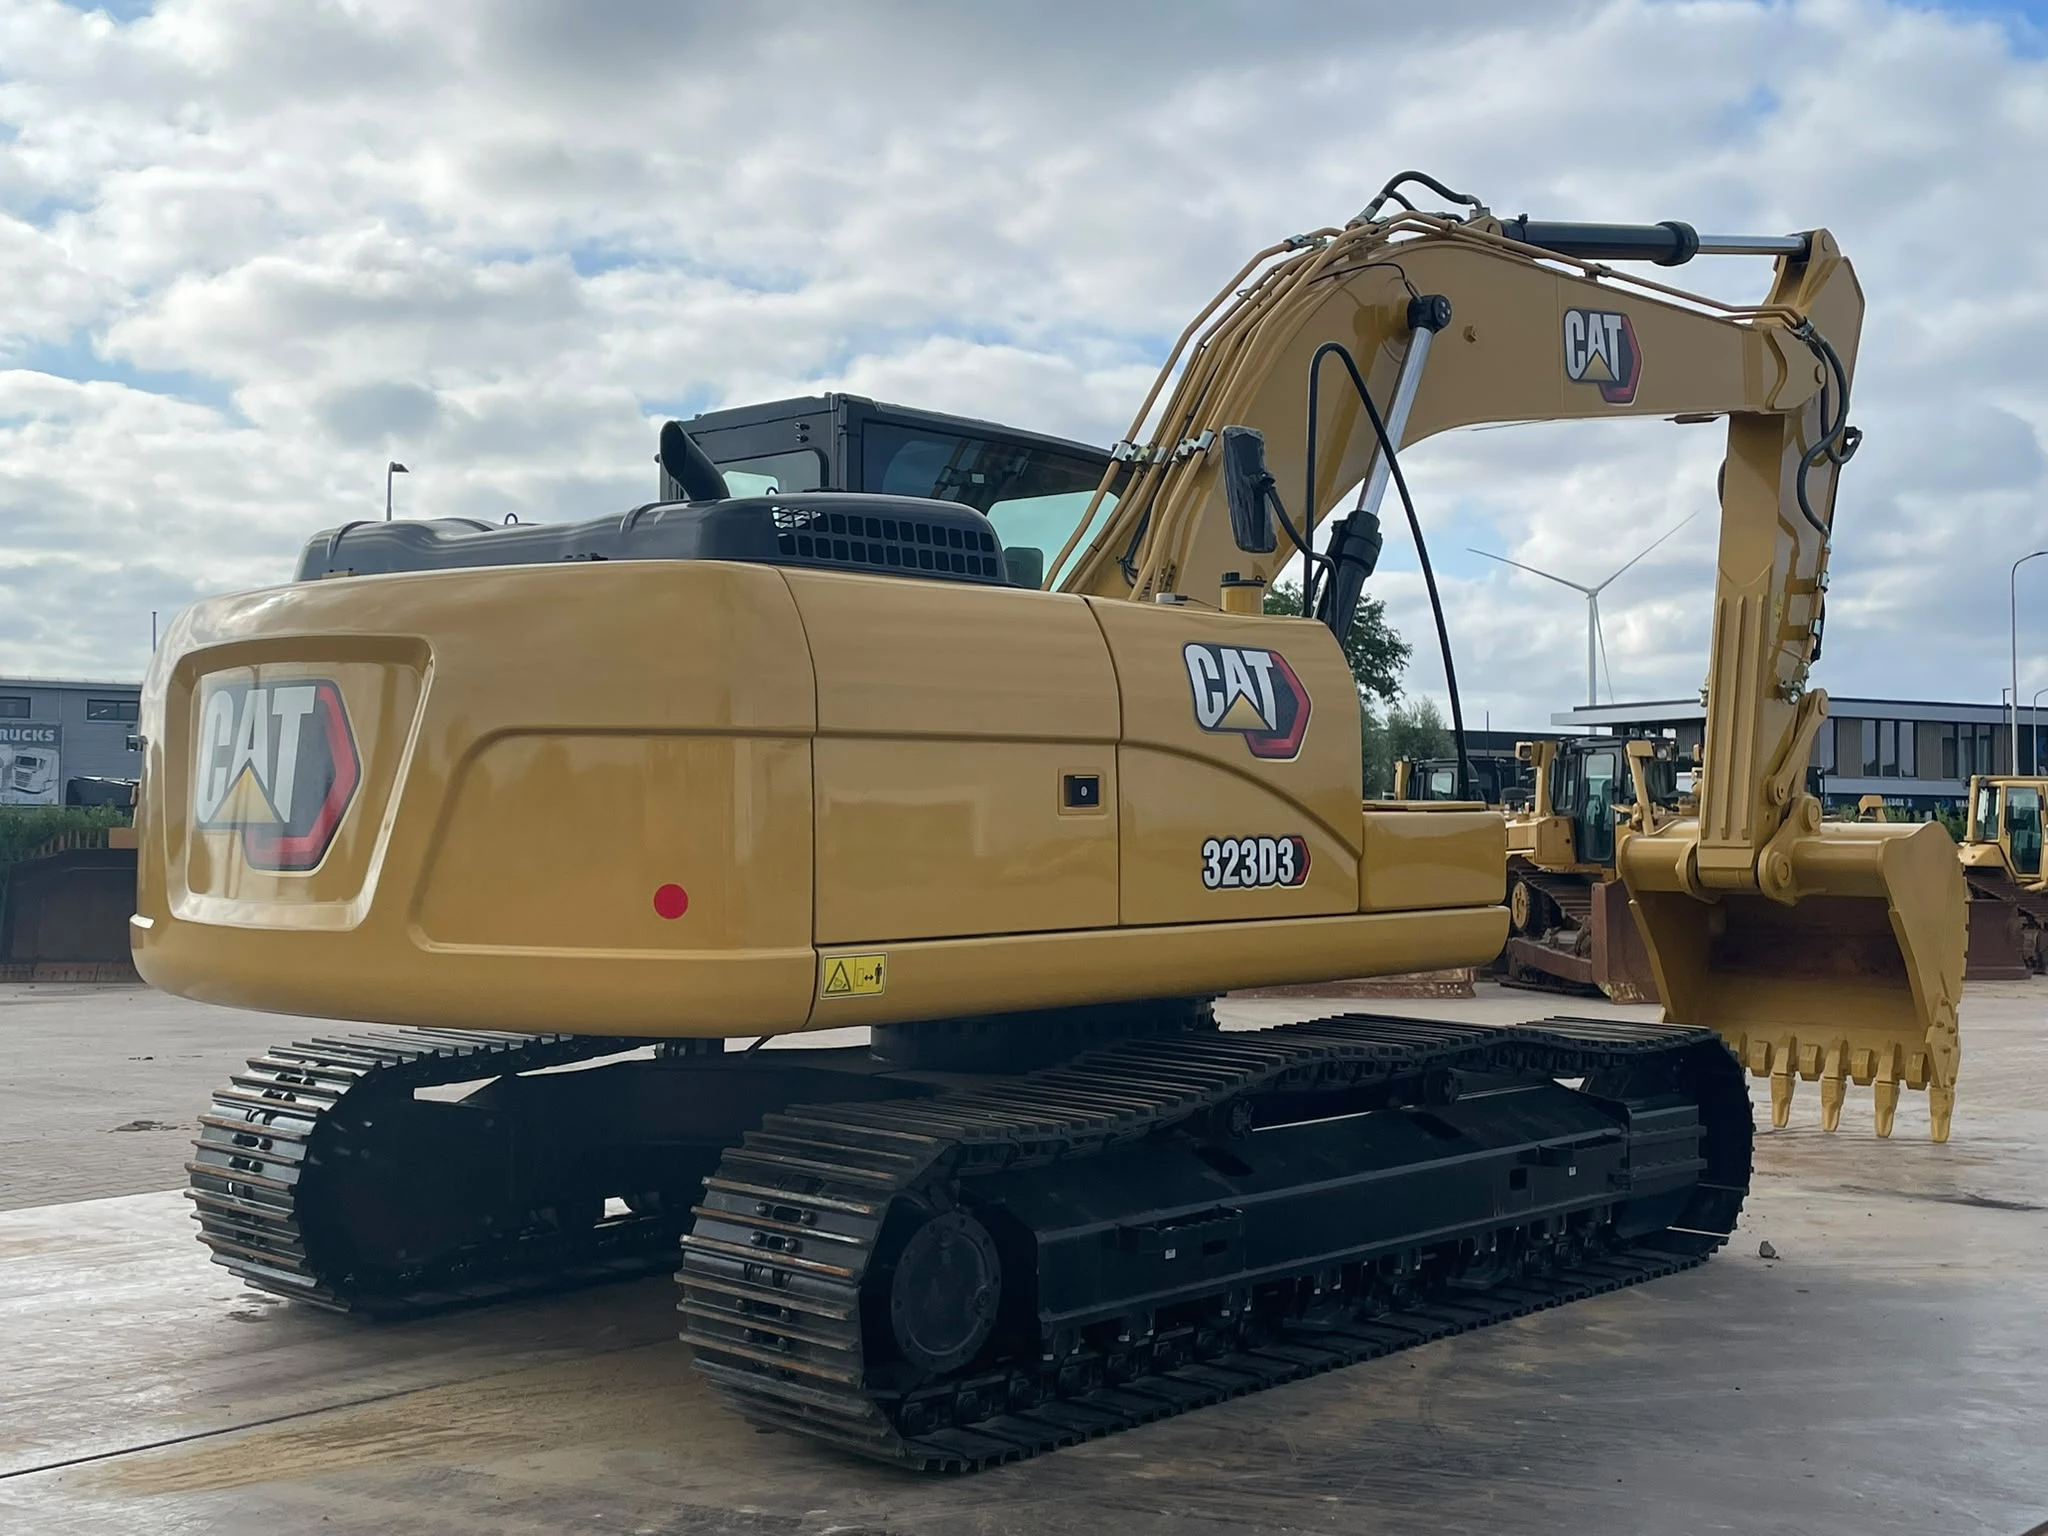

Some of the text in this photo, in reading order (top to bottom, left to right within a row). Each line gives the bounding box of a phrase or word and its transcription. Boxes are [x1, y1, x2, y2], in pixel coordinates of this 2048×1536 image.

[1564, 310, 1622, 381] CAT
[1184, 644, 1277, 731] CAT
[0, 729, 55, 741] RUCKS
[196, 686, 316, 823] CAT
[1203, 838, 1295, 887] 323D3
